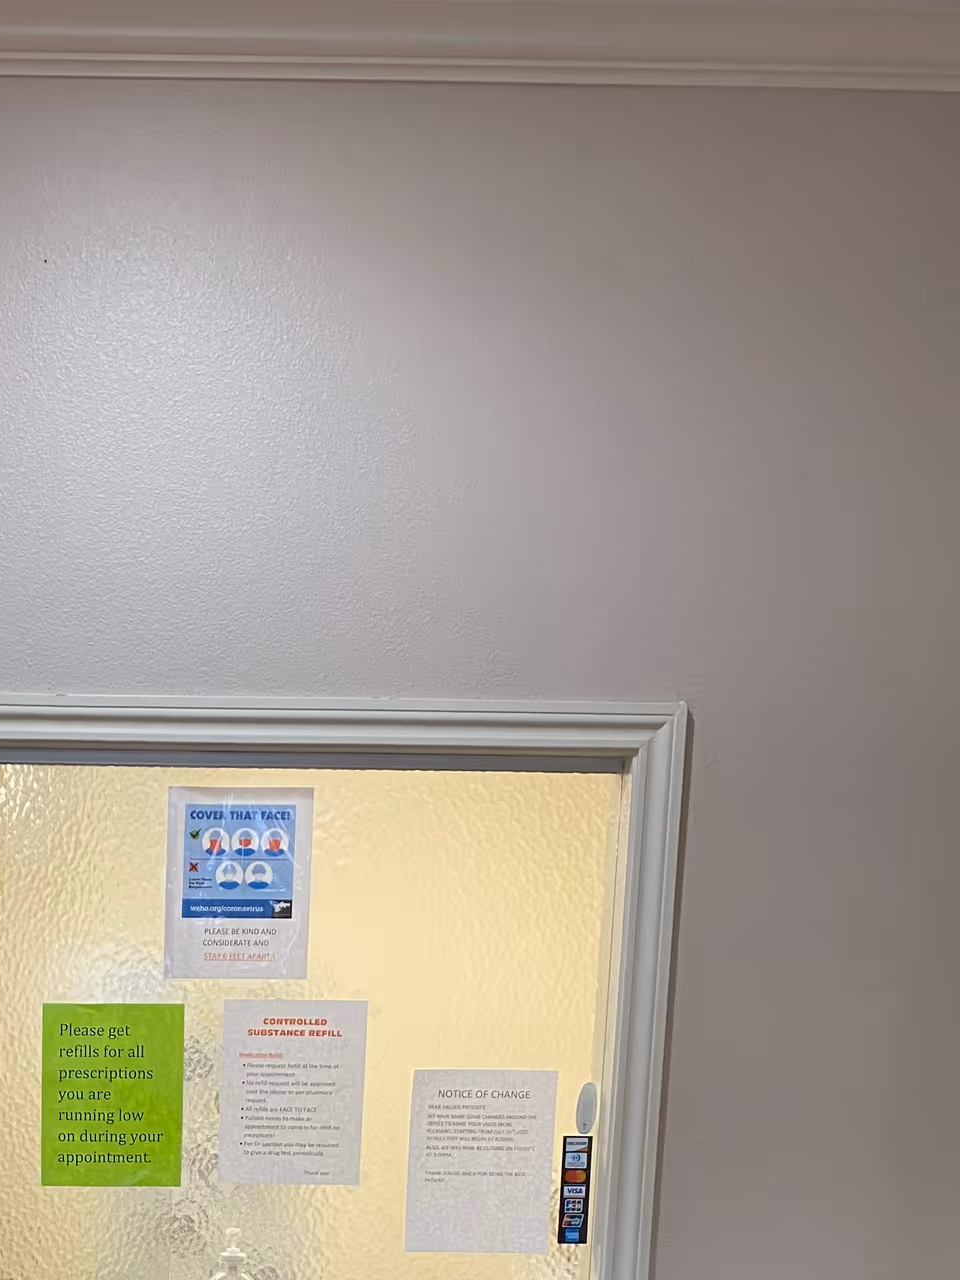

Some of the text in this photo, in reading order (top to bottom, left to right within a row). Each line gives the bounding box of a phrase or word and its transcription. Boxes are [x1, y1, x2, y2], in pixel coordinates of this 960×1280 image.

[190, 810, 290, 821] COVER THAT FACE!
[190, 905, 264, 913] weho.org/coronavirus
[261, 928, 276, 936] AND
[60, 1023, 130, 1039] Please get
[248, 1029, 306, 1037] SUBSTANCE
[59, 1045, 145, 1058] refills for all
[59, 1067, 153, 1082] prescriptions
[58, 1089, 111, 1102] you are
[438, 1090, 530, 1099] NOTICE OF CHANGE
[58, 1109, 144, 1124] running low
[58, 1130, 163, 1145] on during your
[58, 1152, 152, 1166] appointment.
